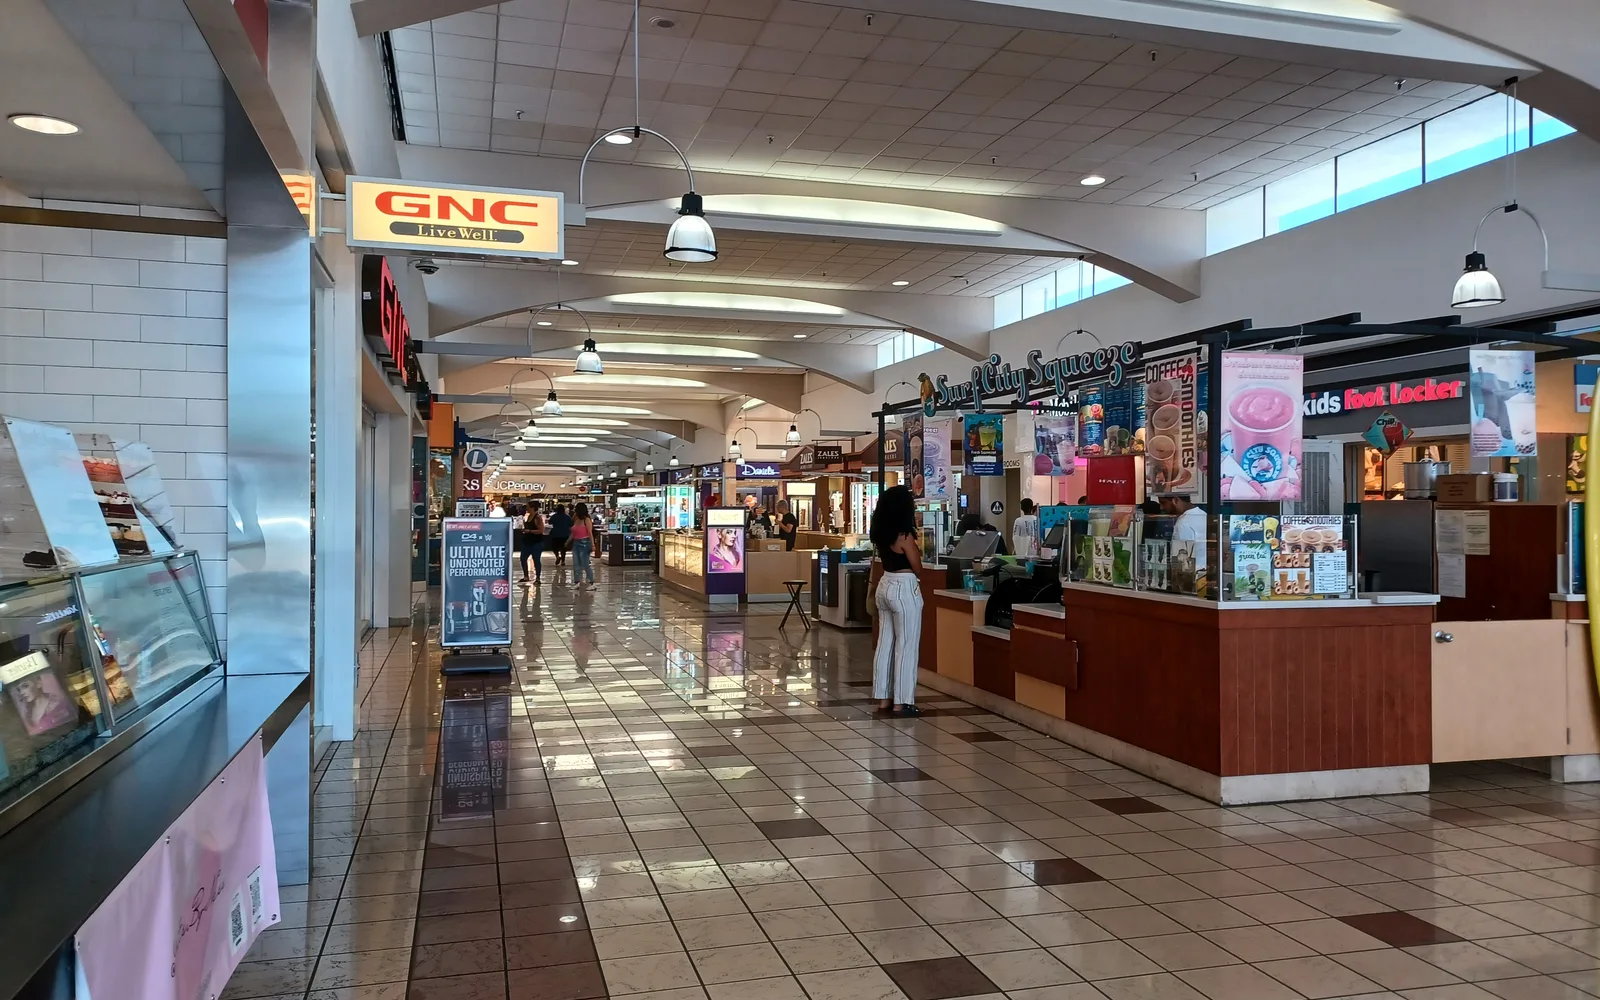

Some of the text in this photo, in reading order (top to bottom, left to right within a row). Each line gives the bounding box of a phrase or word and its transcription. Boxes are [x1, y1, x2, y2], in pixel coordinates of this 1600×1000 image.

[375, 190, 538, 227] GNC
[936, 342, 1137, 412] Surf City Squeeze
[1145, 358, 1184, 384] COFFEE
[1390, 378, 1462, 405] Locker
[1181, 374, 1195, 468] SMOOTHIES
[471, 451, 484, 468] L
[800, 452, 813, 465] ZALES
[493, 480, 545, 492] JCPenney
[1282, 515, 1341, 525] COFFEE SMOOTHIES
[449, 545, 506, 559] ULTIMATE
[449, 558, 505, 568] UNDISPUTED
[449, 568, 505, 577] PERFORMANCE
